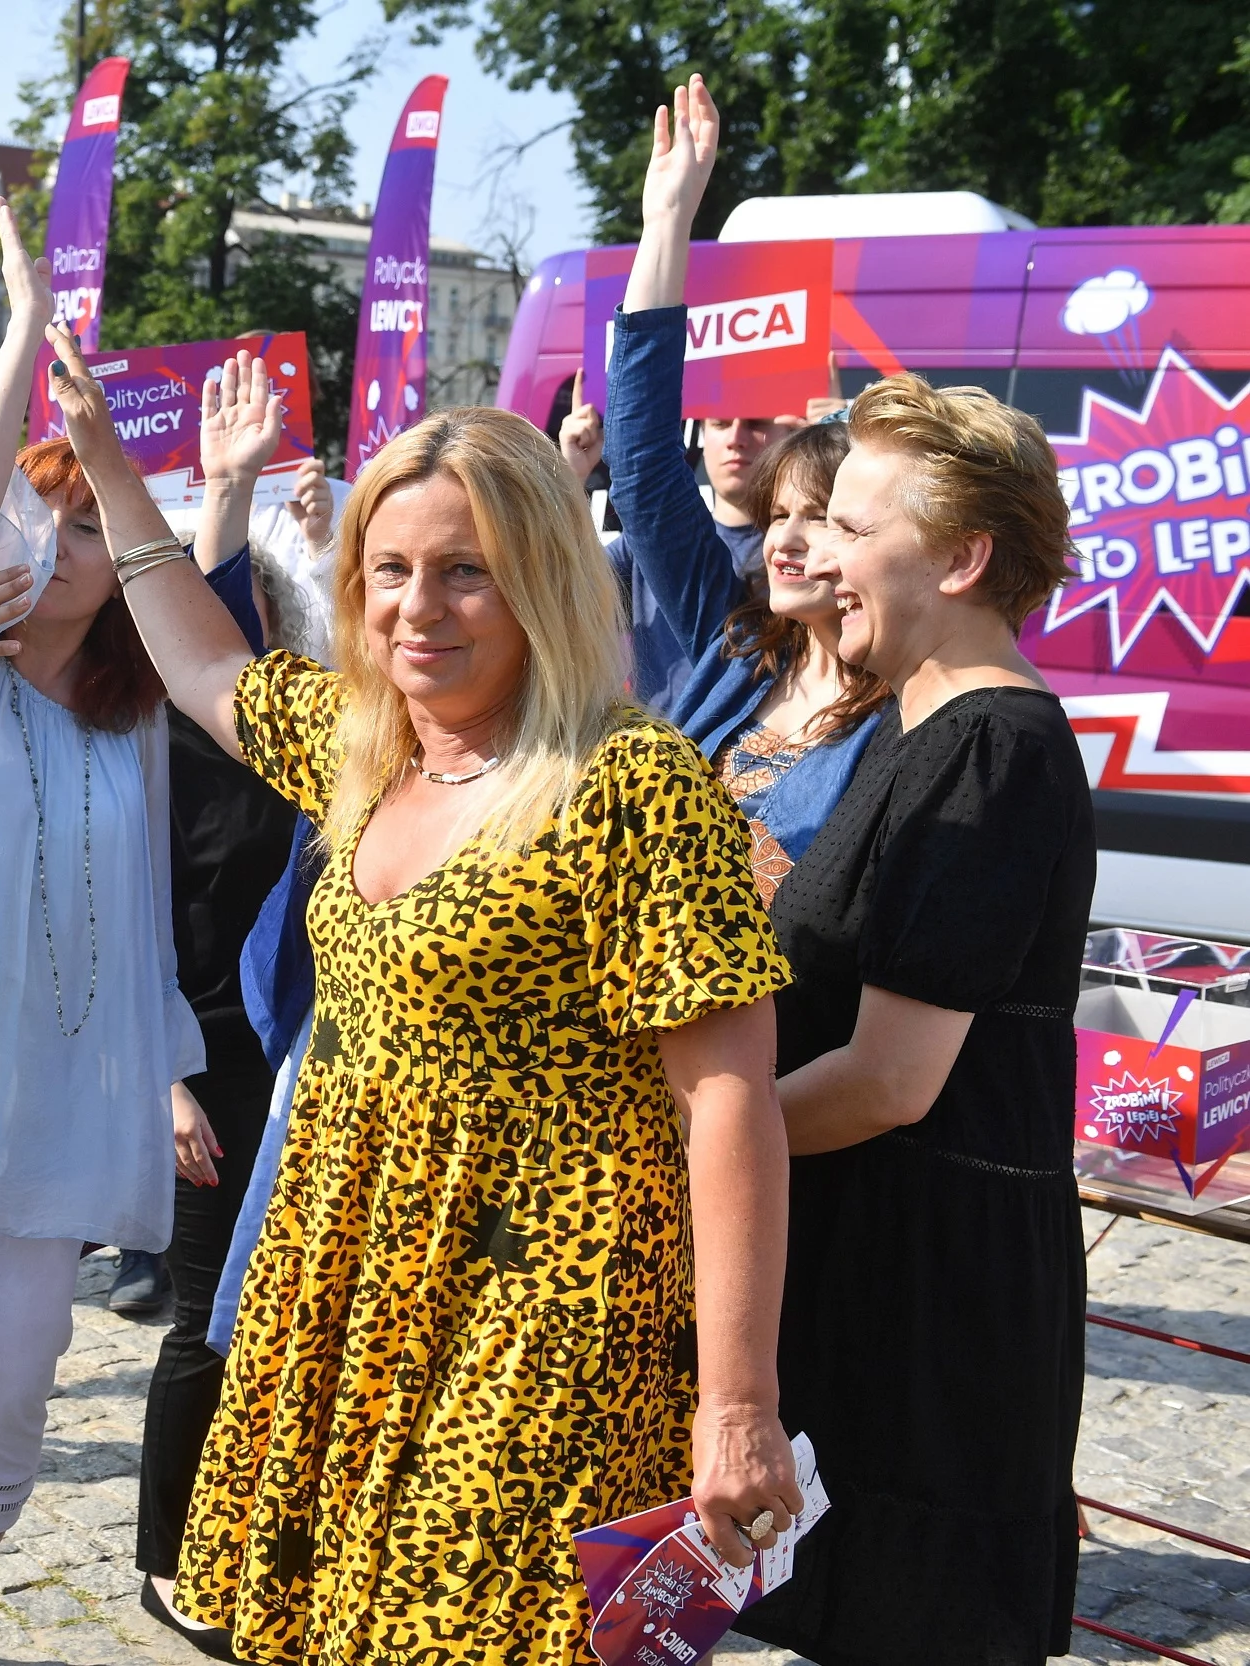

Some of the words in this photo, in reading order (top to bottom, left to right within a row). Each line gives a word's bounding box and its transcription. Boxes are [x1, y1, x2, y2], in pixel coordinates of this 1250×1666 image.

[105, 376, 187, 412] olityczki
[114, 408, 184, 440] WICY
[1070, 535, 1137, 583] TO
[1154, 518, 1250, 574] LEP
[1108, 1111, 1125, 1124] TO
[1203, 1090, 1250, 1130] LEWICY
[655, 1627, 698, 1665] LEWICY
